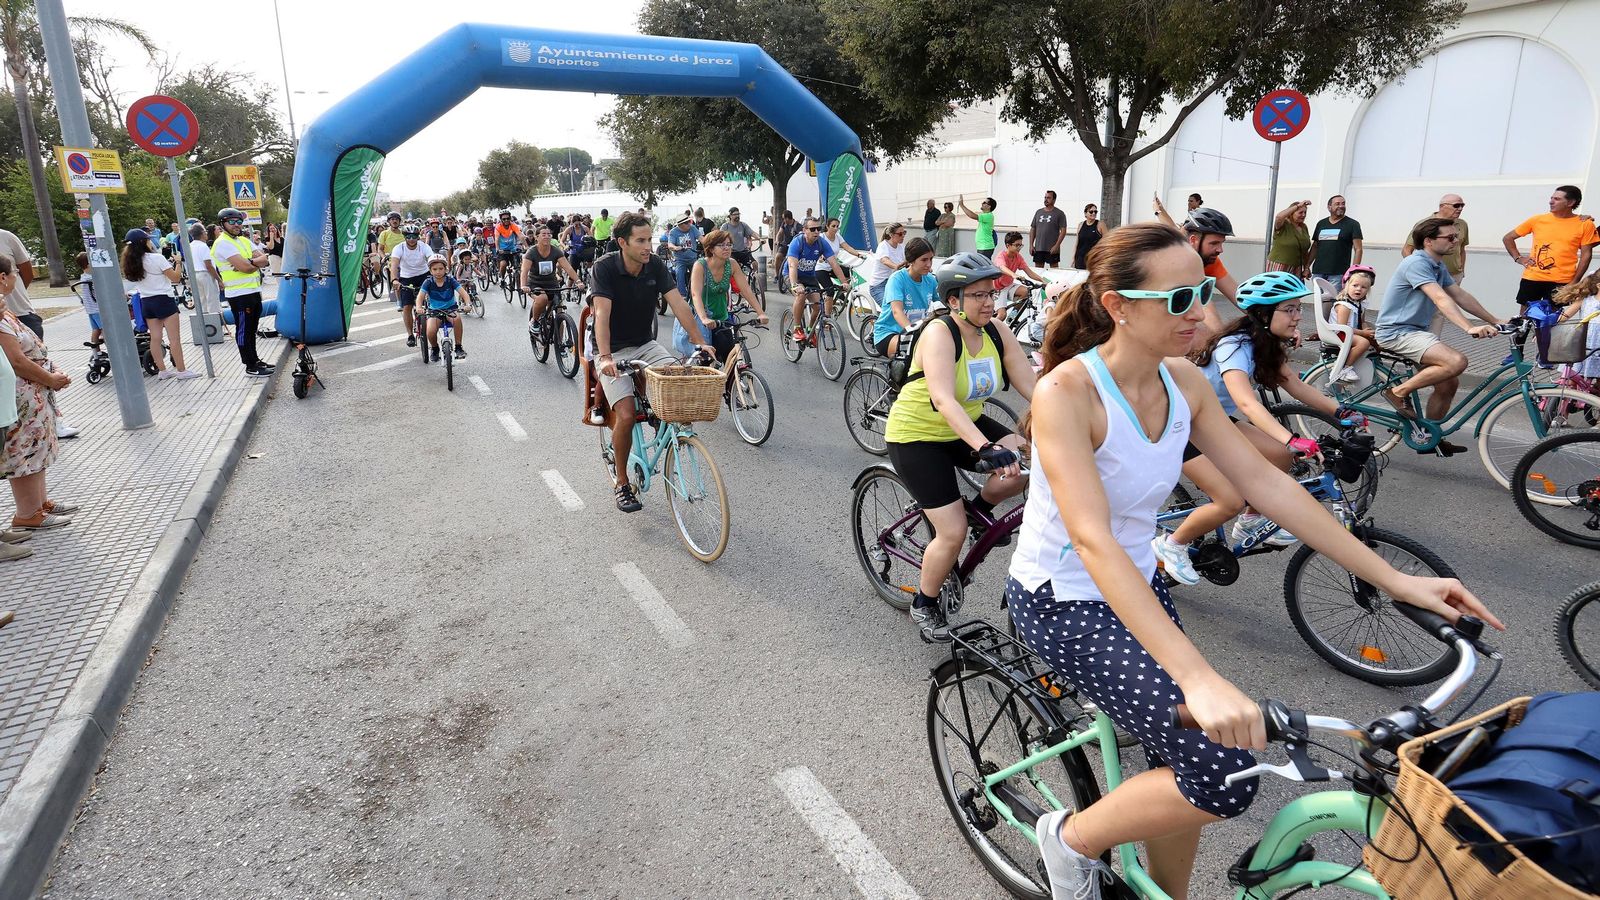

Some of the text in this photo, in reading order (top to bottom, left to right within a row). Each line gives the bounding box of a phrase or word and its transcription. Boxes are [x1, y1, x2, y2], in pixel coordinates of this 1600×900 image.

[537, 44, 733, 66] Ayuntamiento de Jerez
[537, 56, 600, 68] Deportes
